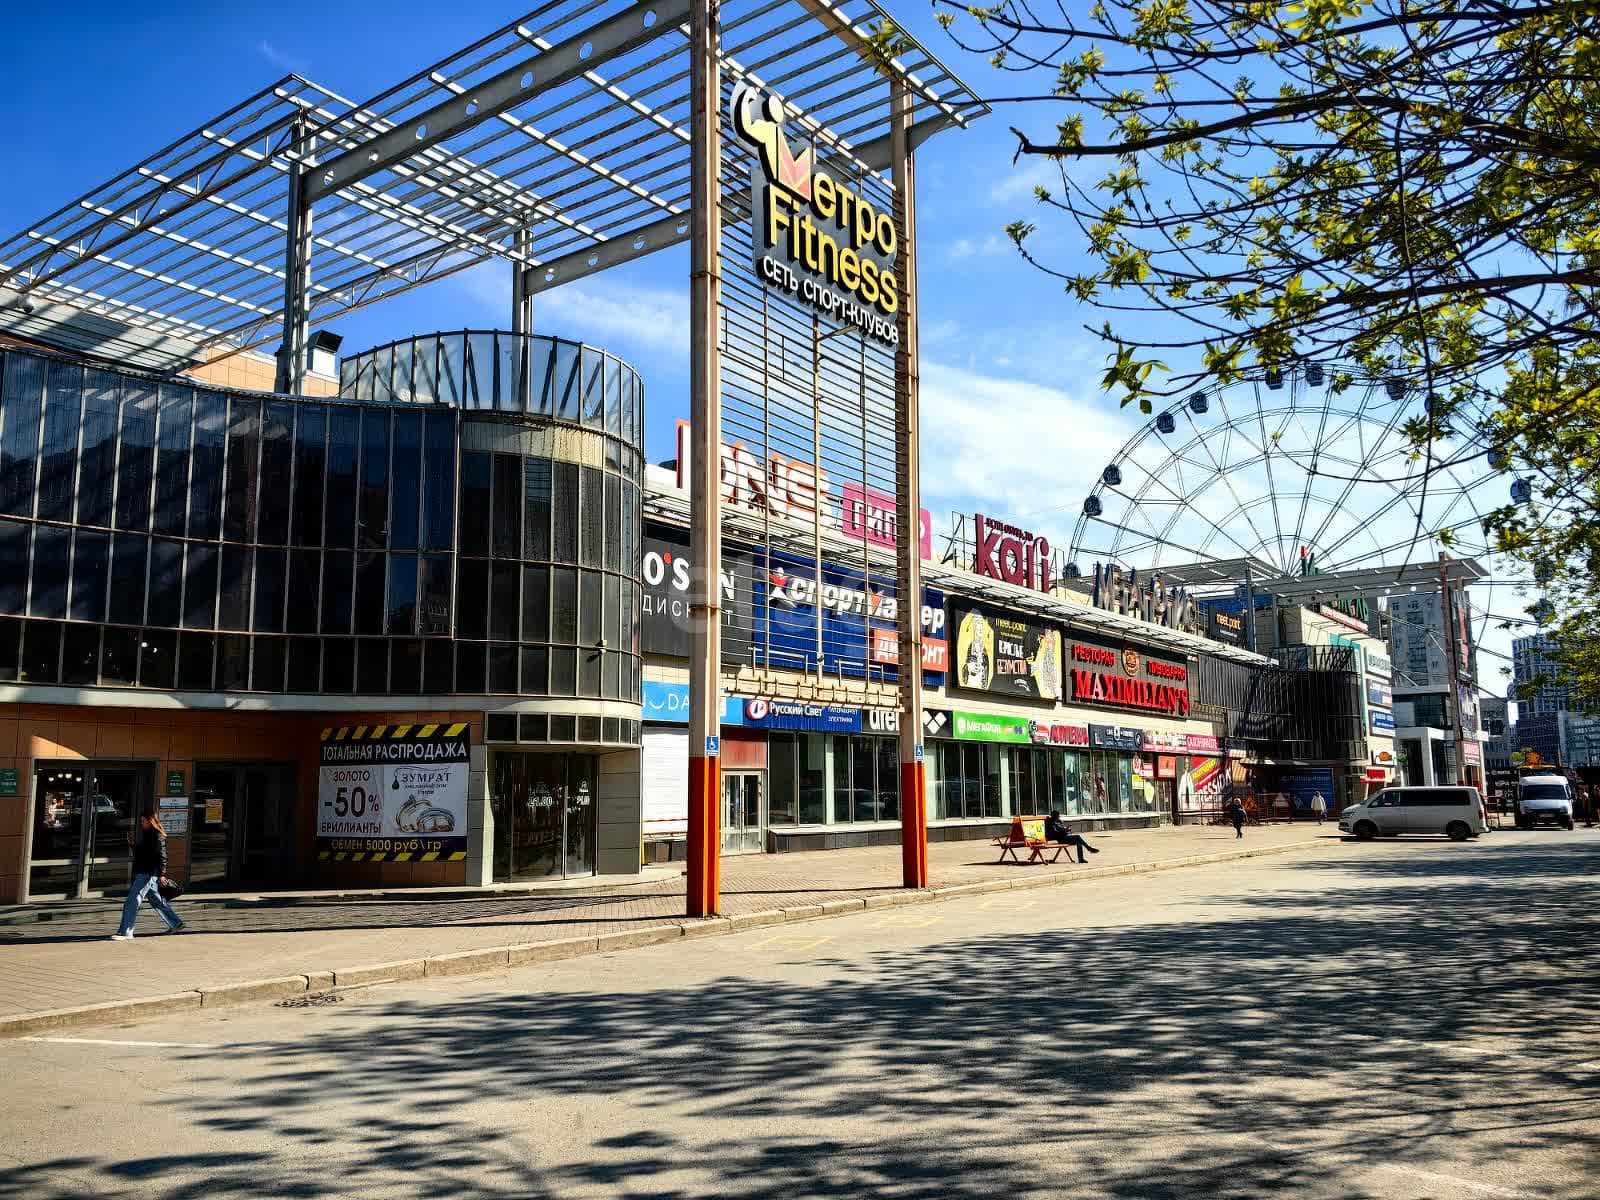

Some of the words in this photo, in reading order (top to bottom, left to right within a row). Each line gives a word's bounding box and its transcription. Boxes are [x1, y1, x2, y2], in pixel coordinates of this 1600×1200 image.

[769, 183, 897, 314] Fitness
[763, 255, 799, 291] СЕТЬ
[803, 280, 899, 344] СПОРТ-КЛУБОВ
[975, 513, 1050, 594] kari
[642, 551, 735, 600] O'SN
[790, 578, 945, 634] спортмаер
[1072, 644, 1116, 667] РЕСТОРАН
[1074, 668, 1190, 716] MAXIMILIAN'S
[769, 701, 803, 716] Русский
[804, 704, 823, 717] Свет
[323, 745, 373, 760] ТОТАЛЬНАЯ
[375, 742, 467, 760] РАСПРОДАЖА
[333, 770, 370, 782] ЗОЛОТО
[401, 772, 452, 783] ЗУМРАТ
[324, 786, 380, 818] -50%
[321, 822, 381, 834] БРИЛЛИАНТЫ
[331, 838, 362, 850] ОБМЕН
[366, 839, 392, 850] 5000
